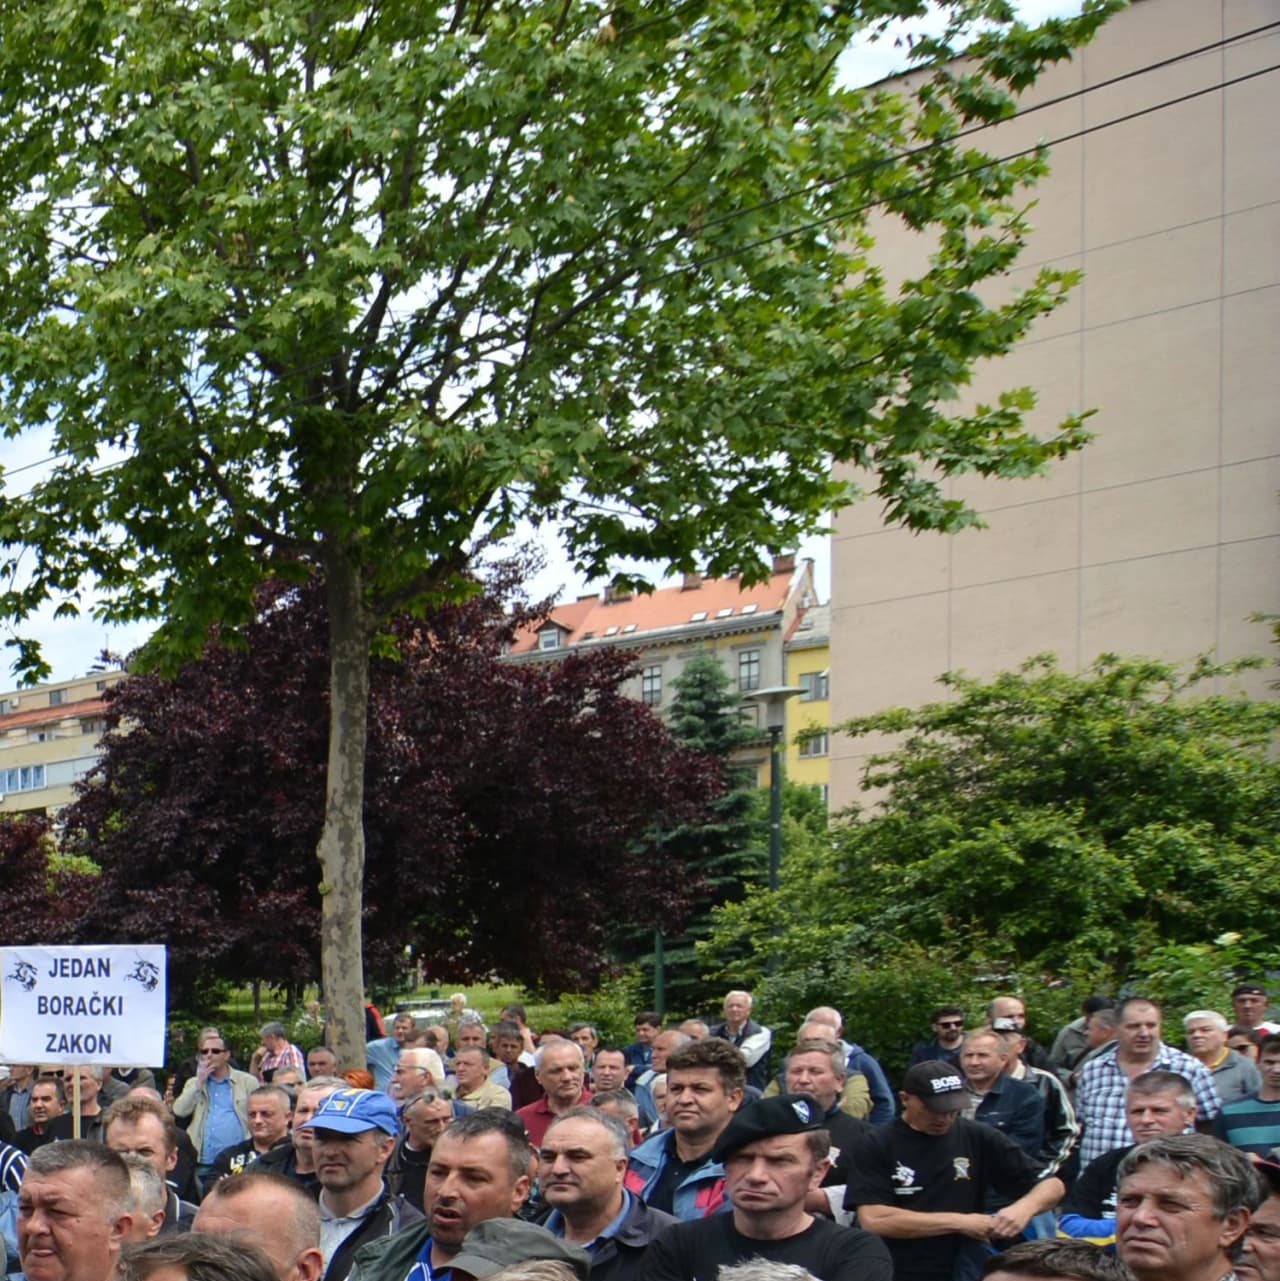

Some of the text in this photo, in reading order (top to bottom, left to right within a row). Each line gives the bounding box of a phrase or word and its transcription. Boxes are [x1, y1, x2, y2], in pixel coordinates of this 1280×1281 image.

[48, 958, 111, 978] JEDAN
[37, 991, 123, 1016] BORAČKI
[45, 1033, 112, 1054] ZAKON
